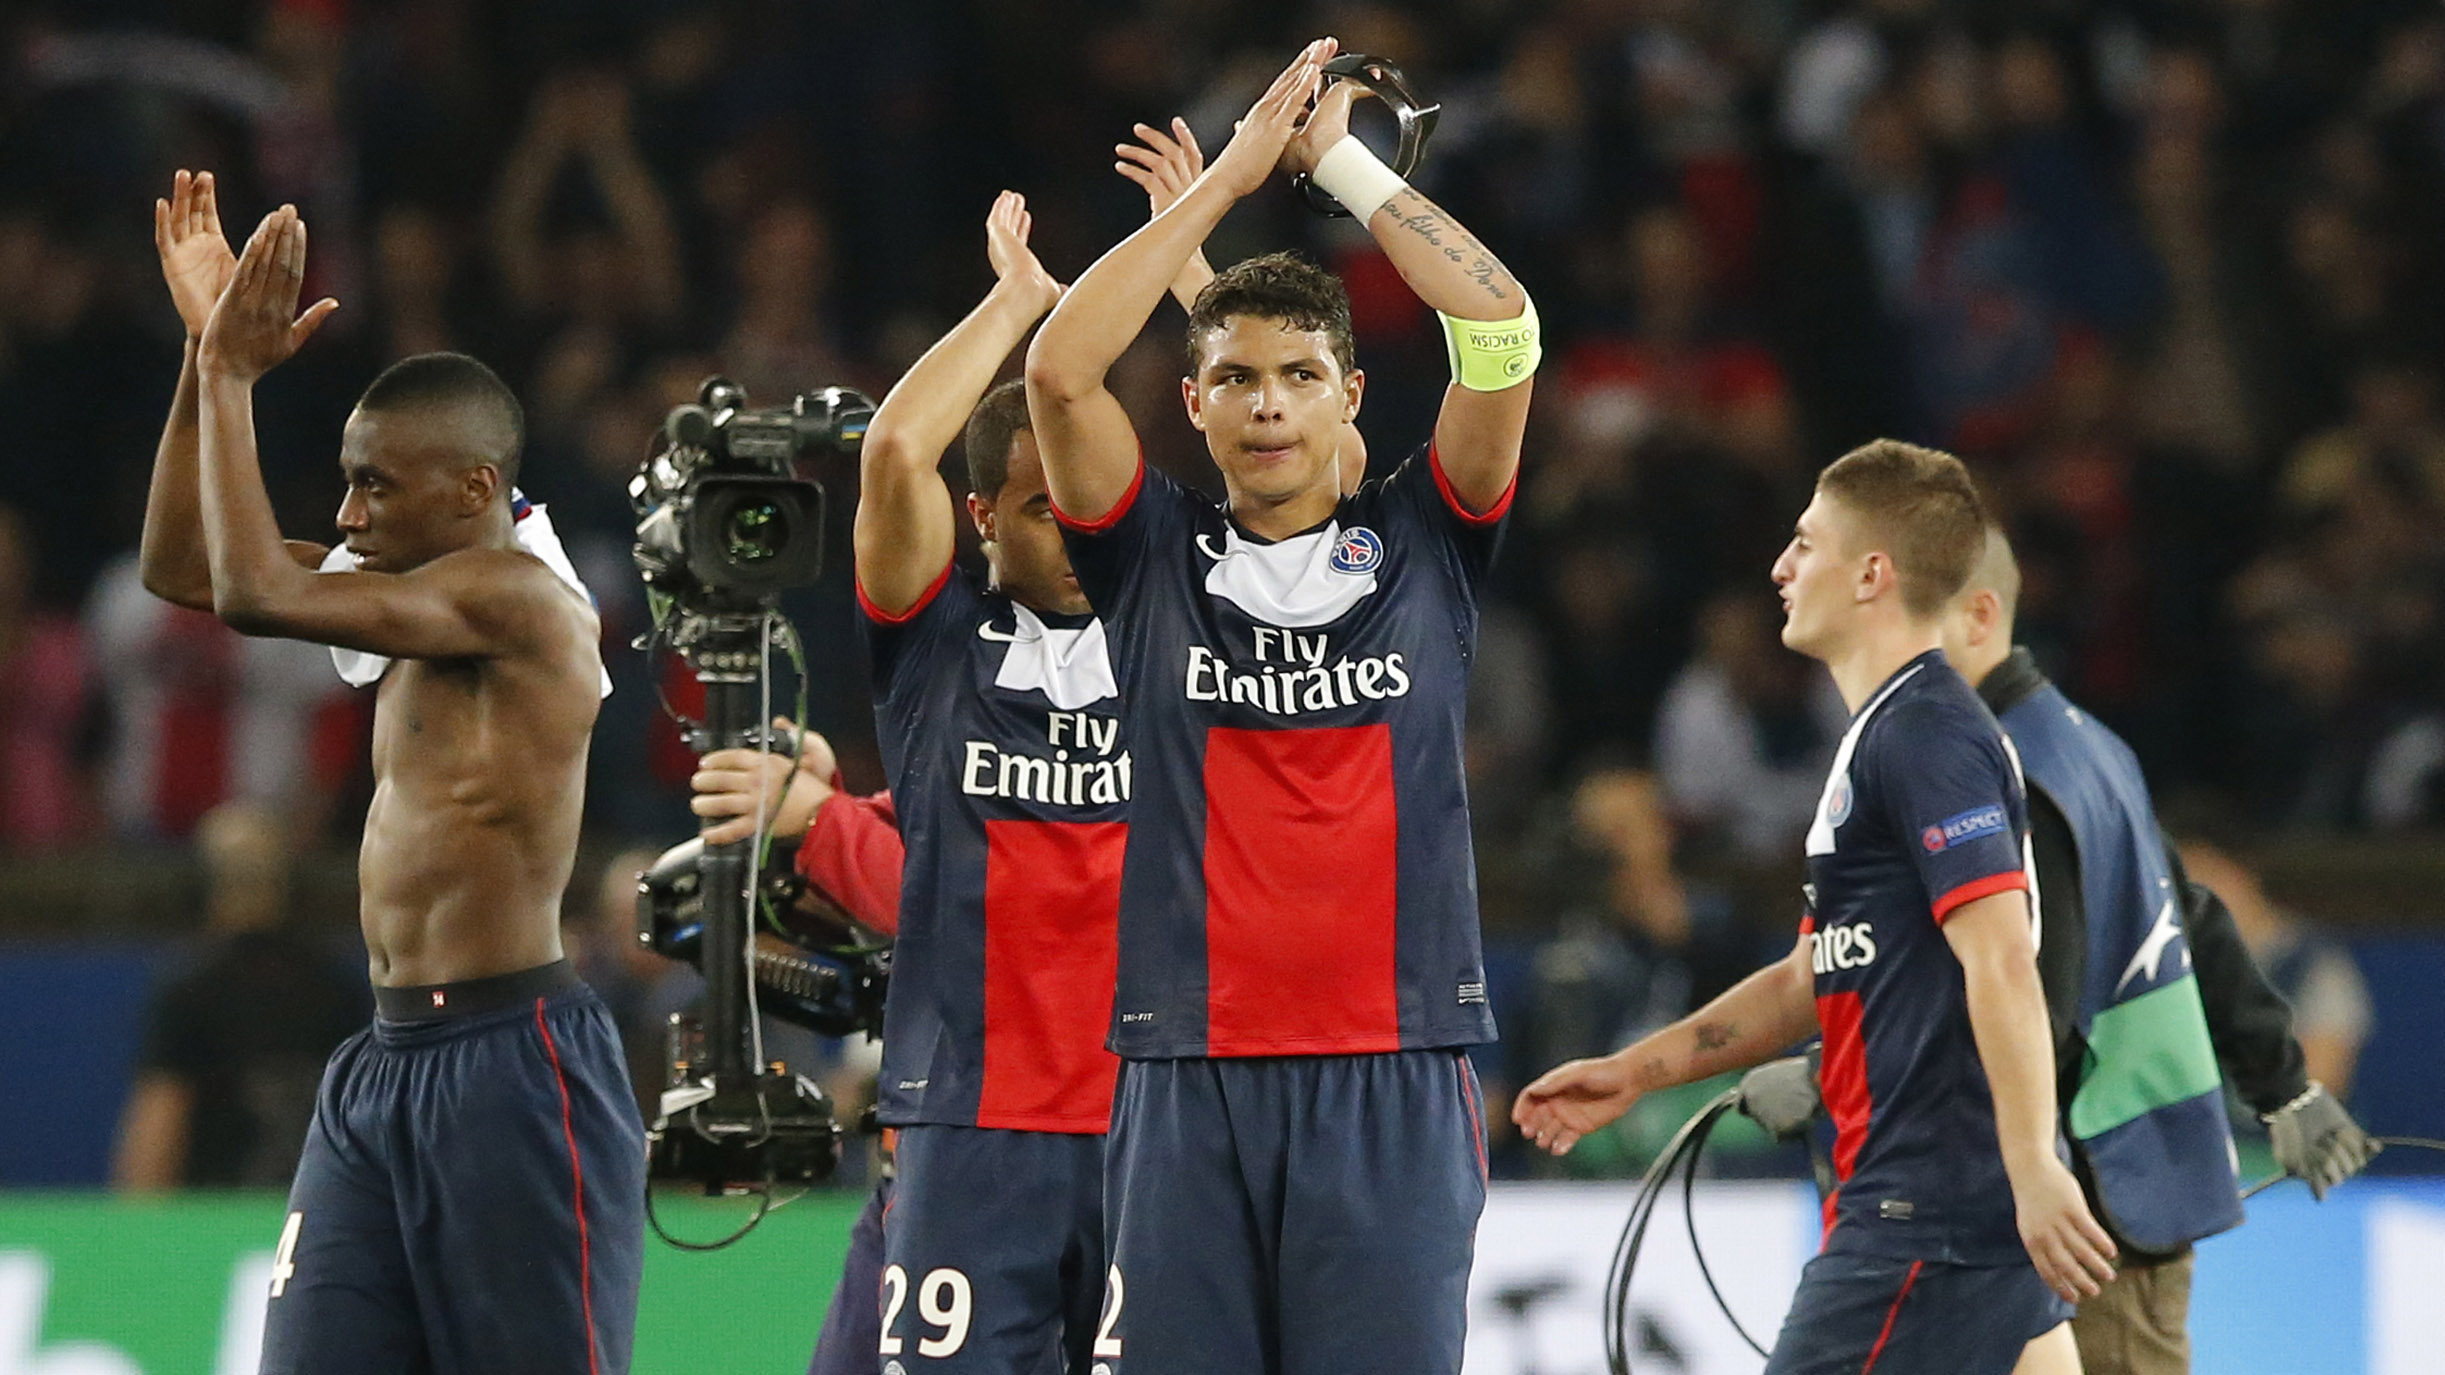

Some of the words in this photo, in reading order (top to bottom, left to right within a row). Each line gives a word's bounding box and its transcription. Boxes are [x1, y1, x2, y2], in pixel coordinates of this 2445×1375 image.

[1399, 214, 1441, 246] filho
[1469, 332, 1519, 348] RACISM
[1251, 625, 1329, 668] Fly
[1186, 645, 1412, 716] Emirates
[1047, 711, 1120, 755] Fly
[1944, 811, 2002, 840] RESPECT
[879, 1263, 972, 1359] 29
[1092, 1262, 1124, 1358] 2
